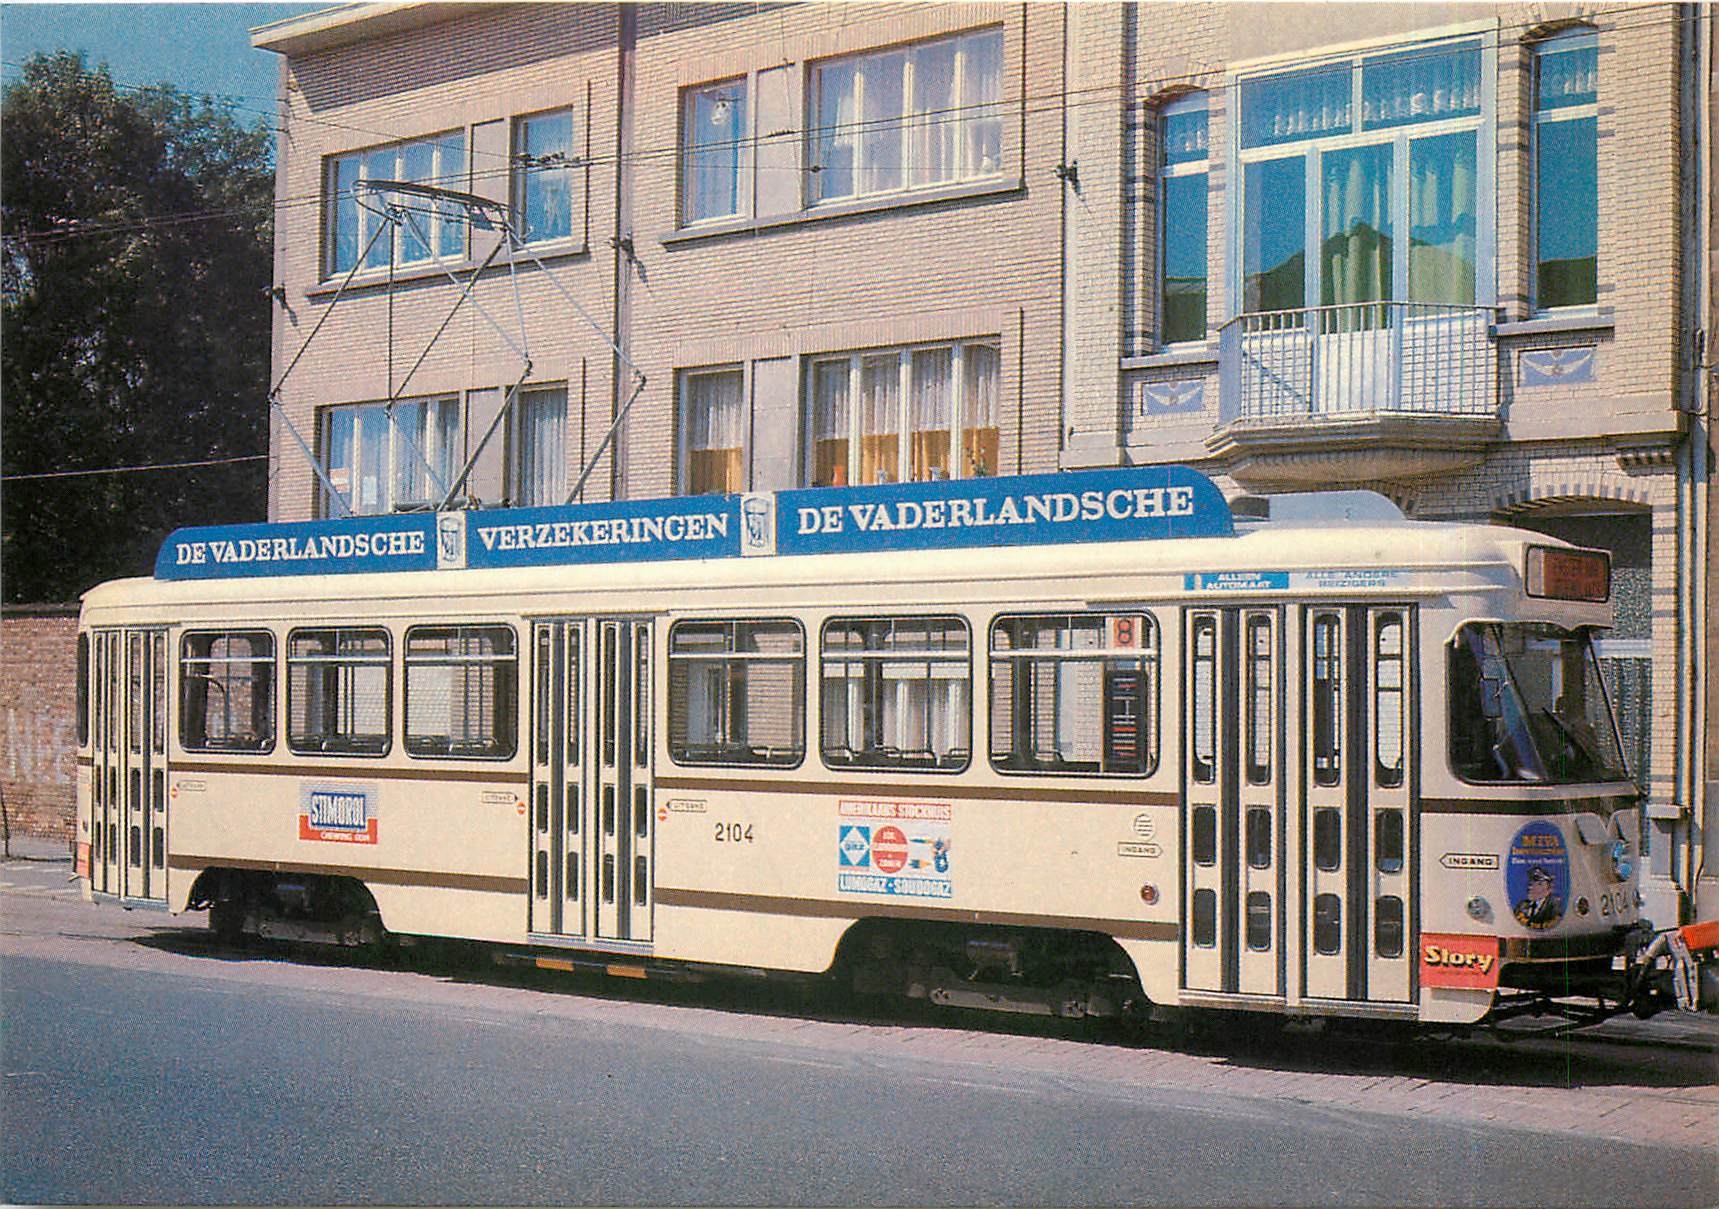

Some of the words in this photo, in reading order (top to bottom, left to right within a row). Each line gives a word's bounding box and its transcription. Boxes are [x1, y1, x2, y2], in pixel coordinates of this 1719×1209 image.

[798, 507, 843, 534] DE
[848, 486, 1195, 531] VADERLANDSCHE
[477, 513, 728, 551] VERZEKERINGEN
[176, 543, 206, 564] DE
[208, 531, 425, 562] VADERLANDSCHE
[1206, 581, 1272, 589] AUTOMAAT
[1118, 619, 1132, 644] 8
[311, 795, 365, 826] STIMOROL
[715, 823, 754, 842] 2104
[1448, 857, 1494, 866] INGANG
[1424, 945, 1496, 975] Story
